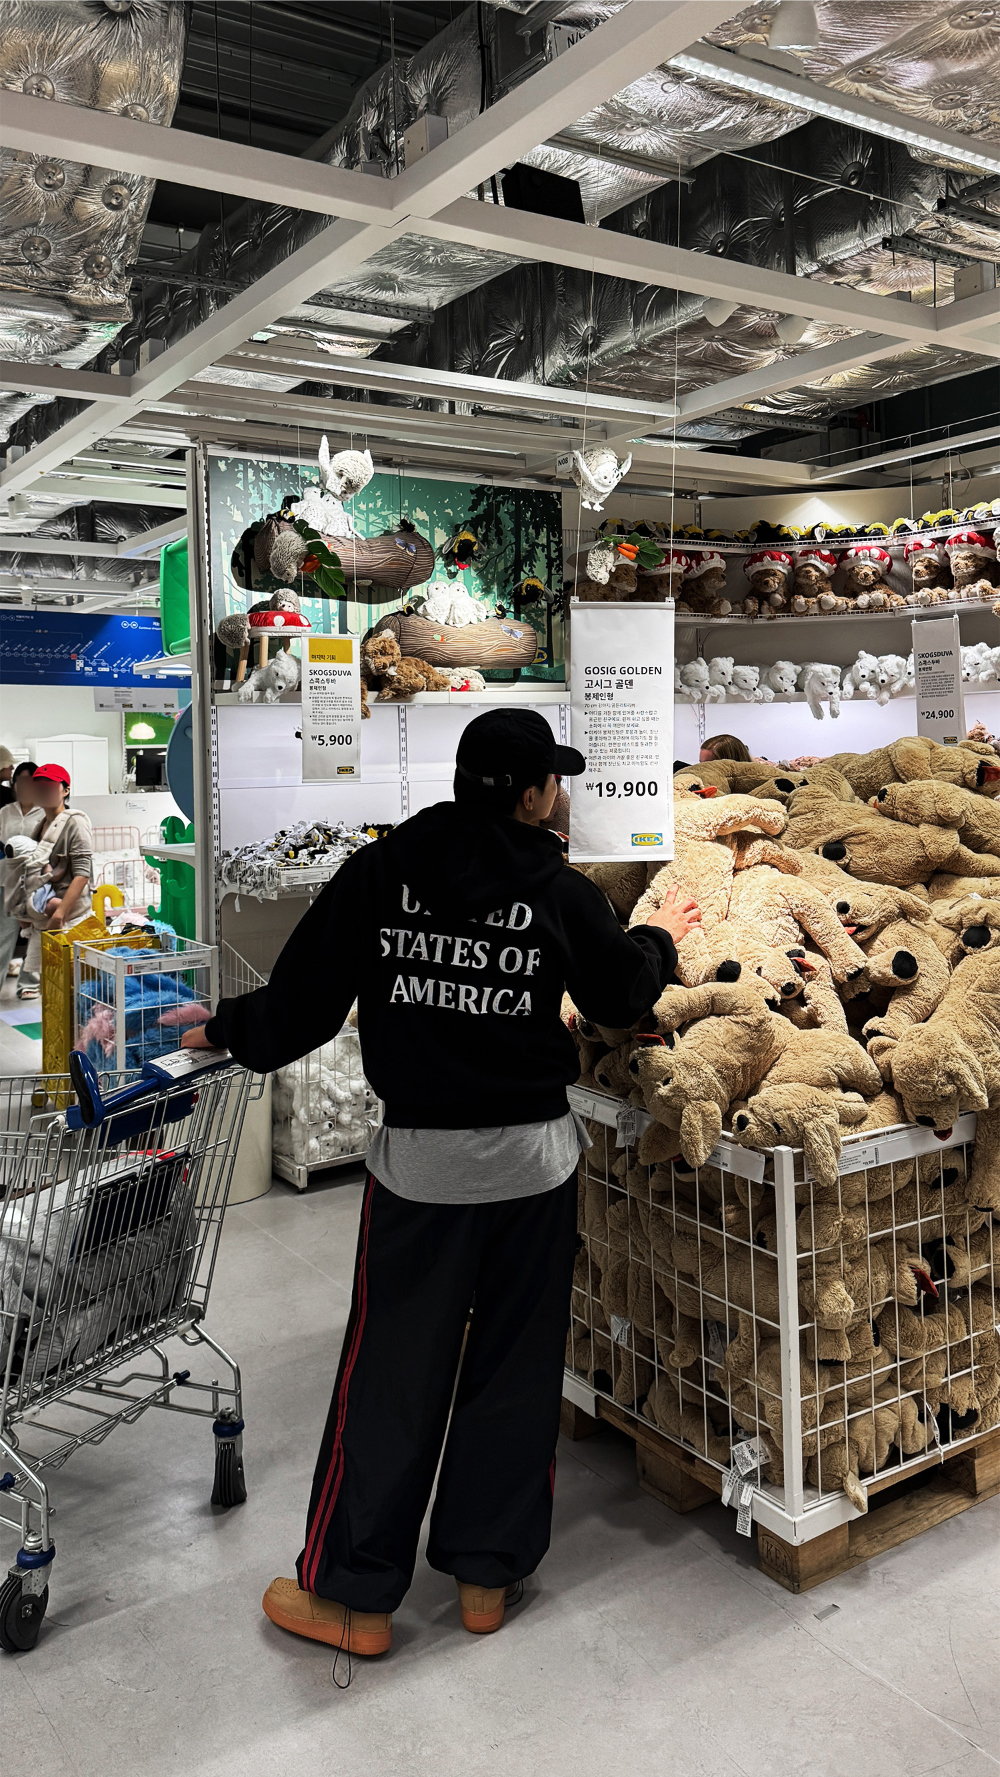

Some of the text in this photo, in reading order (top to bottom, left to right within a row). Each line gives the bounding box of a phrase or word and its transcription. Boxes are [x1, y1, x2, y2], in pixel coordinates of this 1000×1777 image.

[558, 456, 568, 466] N08
[918, 650, 953, 659] SKOGSDUVA
[308, 669, 352, 677] SKOGSDUVA
[584, 666, 662, 676] GOSIG GOLDEN
[584, 678, 612, 690] 고시그
[584, 692, 614, 701] 봉제인형
[921, 710, 954, 719] ₩24,900
[311, 734, 353, 747] ₩5,900
[585, 780, 658, 799] ₩19,900
[401, 884, 533, 931] UED
[380, 928, 542, 976] STATES OF
[389, 974, 532, 1016] AMERICA
